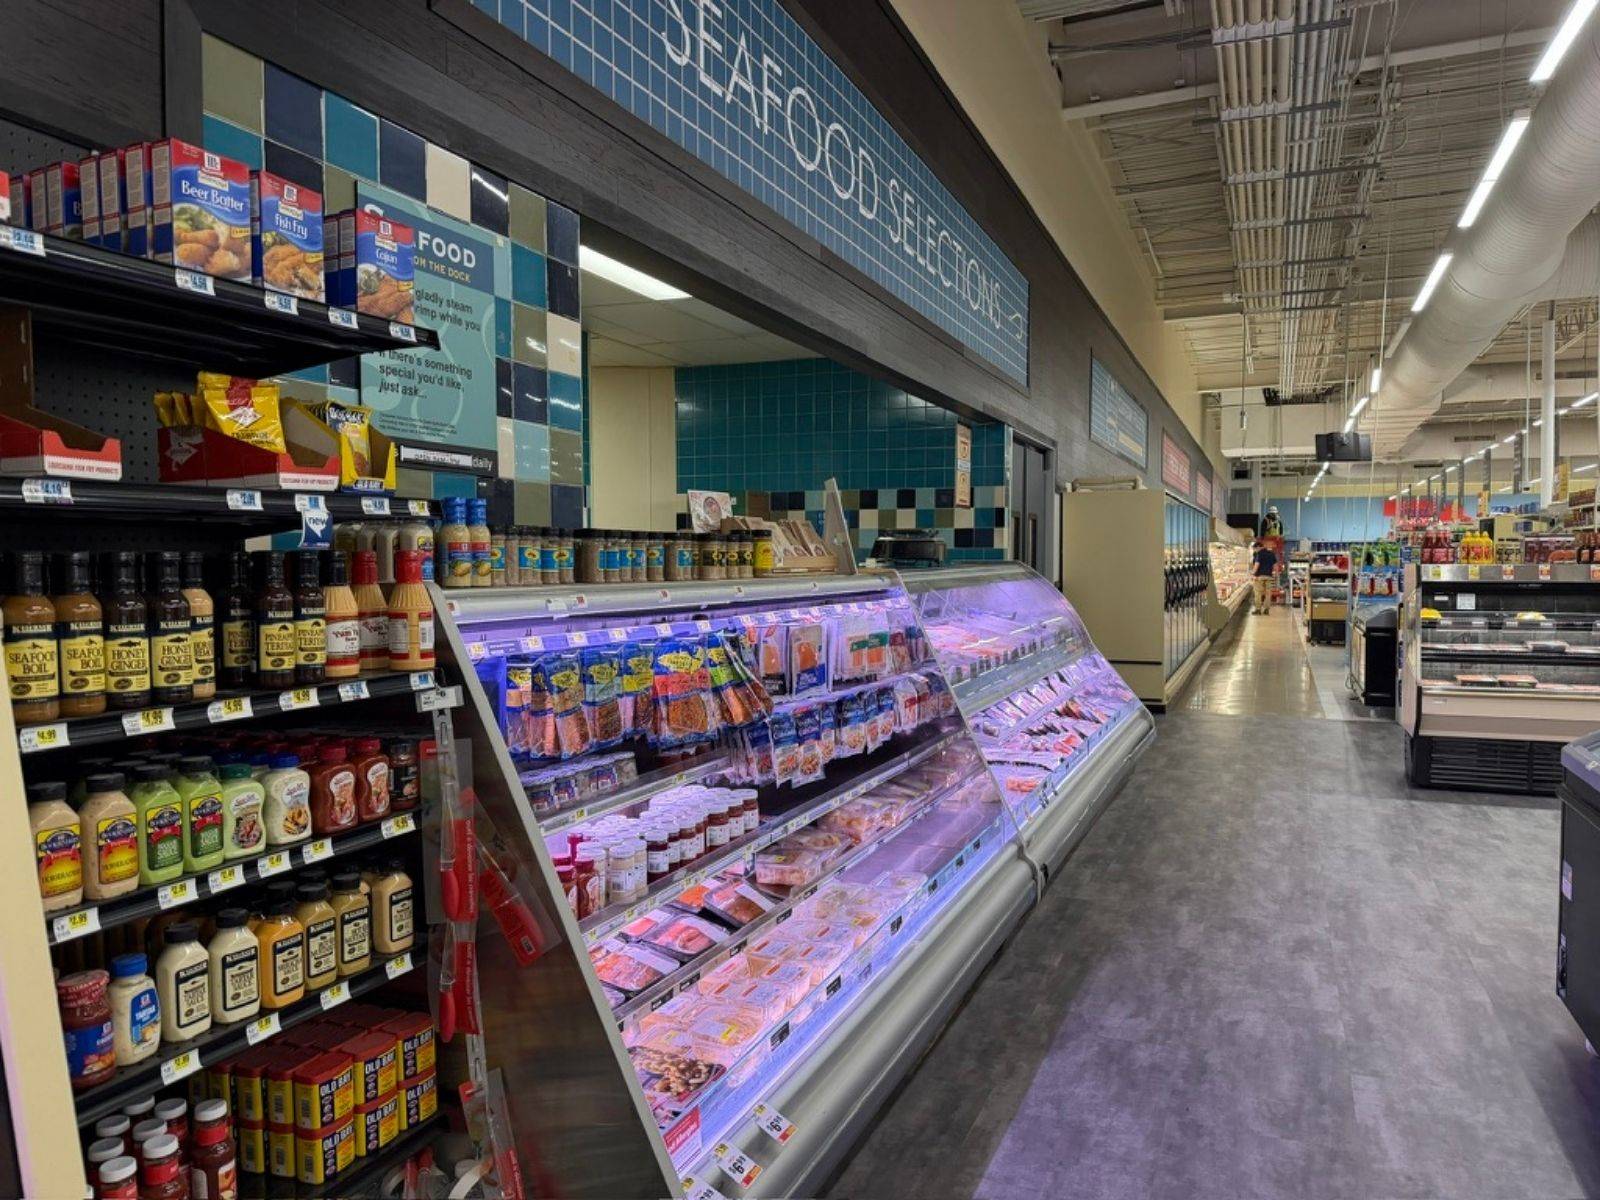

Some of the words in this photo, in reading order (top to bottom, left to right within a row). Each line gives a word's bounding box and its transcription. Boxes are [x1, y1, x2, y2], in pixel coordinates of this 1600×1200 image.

[661, 0, 878, 219] SEAFOOD
[888, 177, 1003, 330] SELECTIONS
[182, 179, 208, 200] Beer
[210, 190, 244, 212] Batter
[428, 261, 446, 275] THE
[448, 266, 471, 283] DOCK
[414, 288, 443, 307] gladly
[446, 297, 473, 315] steam
[414, 305, 438, 320] rimp
[440, 310, 463, 327] while
[465, 319, 481, 333] you
[389, 349, 423, 366] there's
[424, 359, 473, 380] something
[379, 363, 415, 382] special
[417, 371, 445, 388] you'd
[378, 380, 400, 394] just
[308, 516, 327, 528] new
[112, 648, 145, 660] HONEY
[22, 663, 49, 675] BOIL
[405, 1037, 419, 1052] OLD
[365, 1059, 380, 1075] OLD
[320, 1080, 337, 1097] OLD
[407, 1087, 422, 1101] OLD
[366, 1109, 381, 1125] OLD
[323, 1134, 340, 1151] OLD
